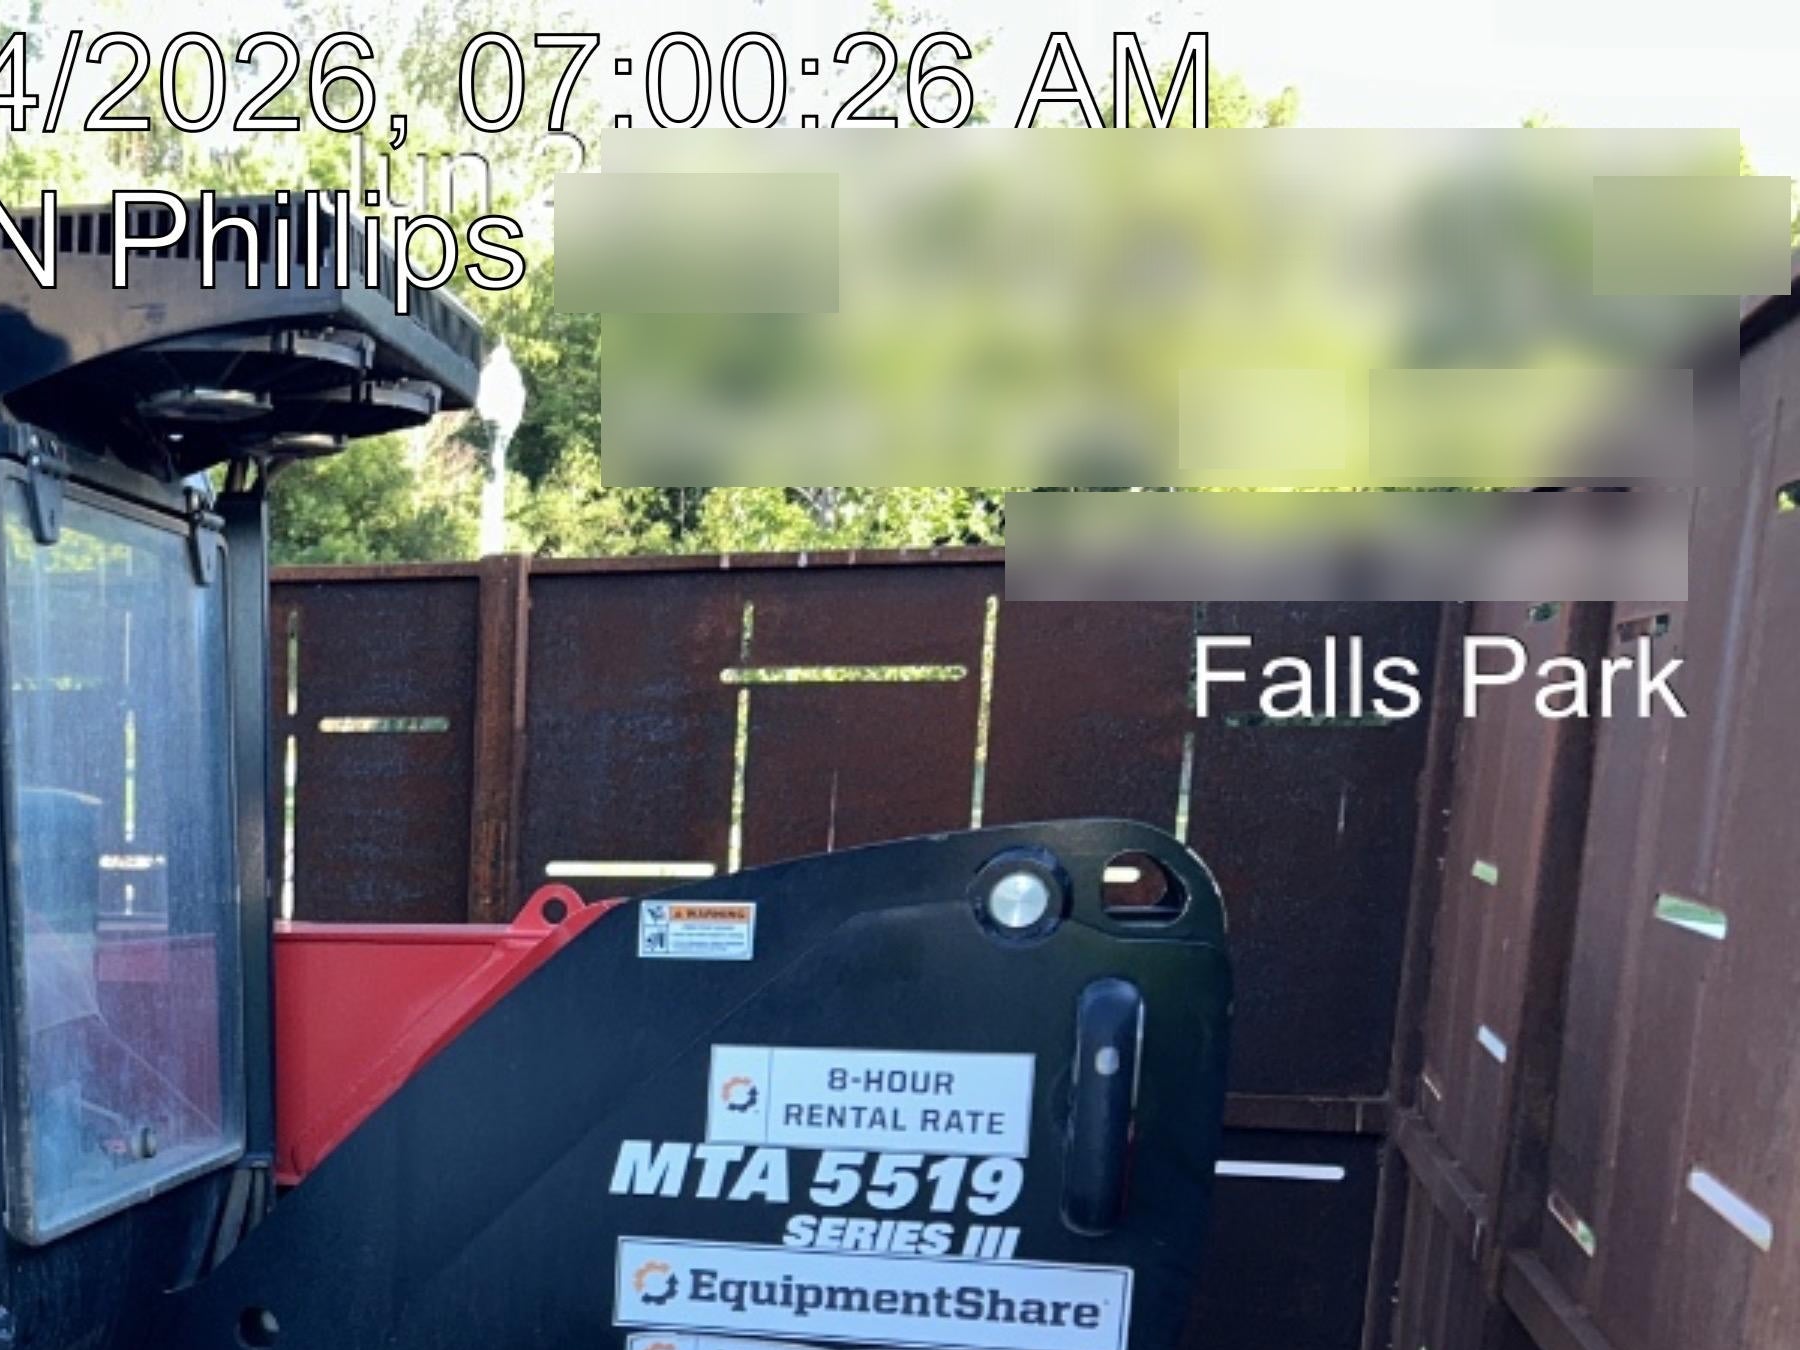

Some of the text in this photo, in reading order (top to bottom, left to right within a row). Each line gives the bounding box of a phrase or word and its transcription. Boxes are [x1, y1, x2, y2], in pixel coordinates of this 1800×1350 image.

[826, 1067, 956, 1096] 8-HOUR
[782, 1102, 1005, 1135] RENTAL RATE
[608, 1139, 1025, 1217] MTA 5519
[782, 1214, 1021, 1260] SERIES III
[686, 1268, 1103, 1330] EquipmentShare
